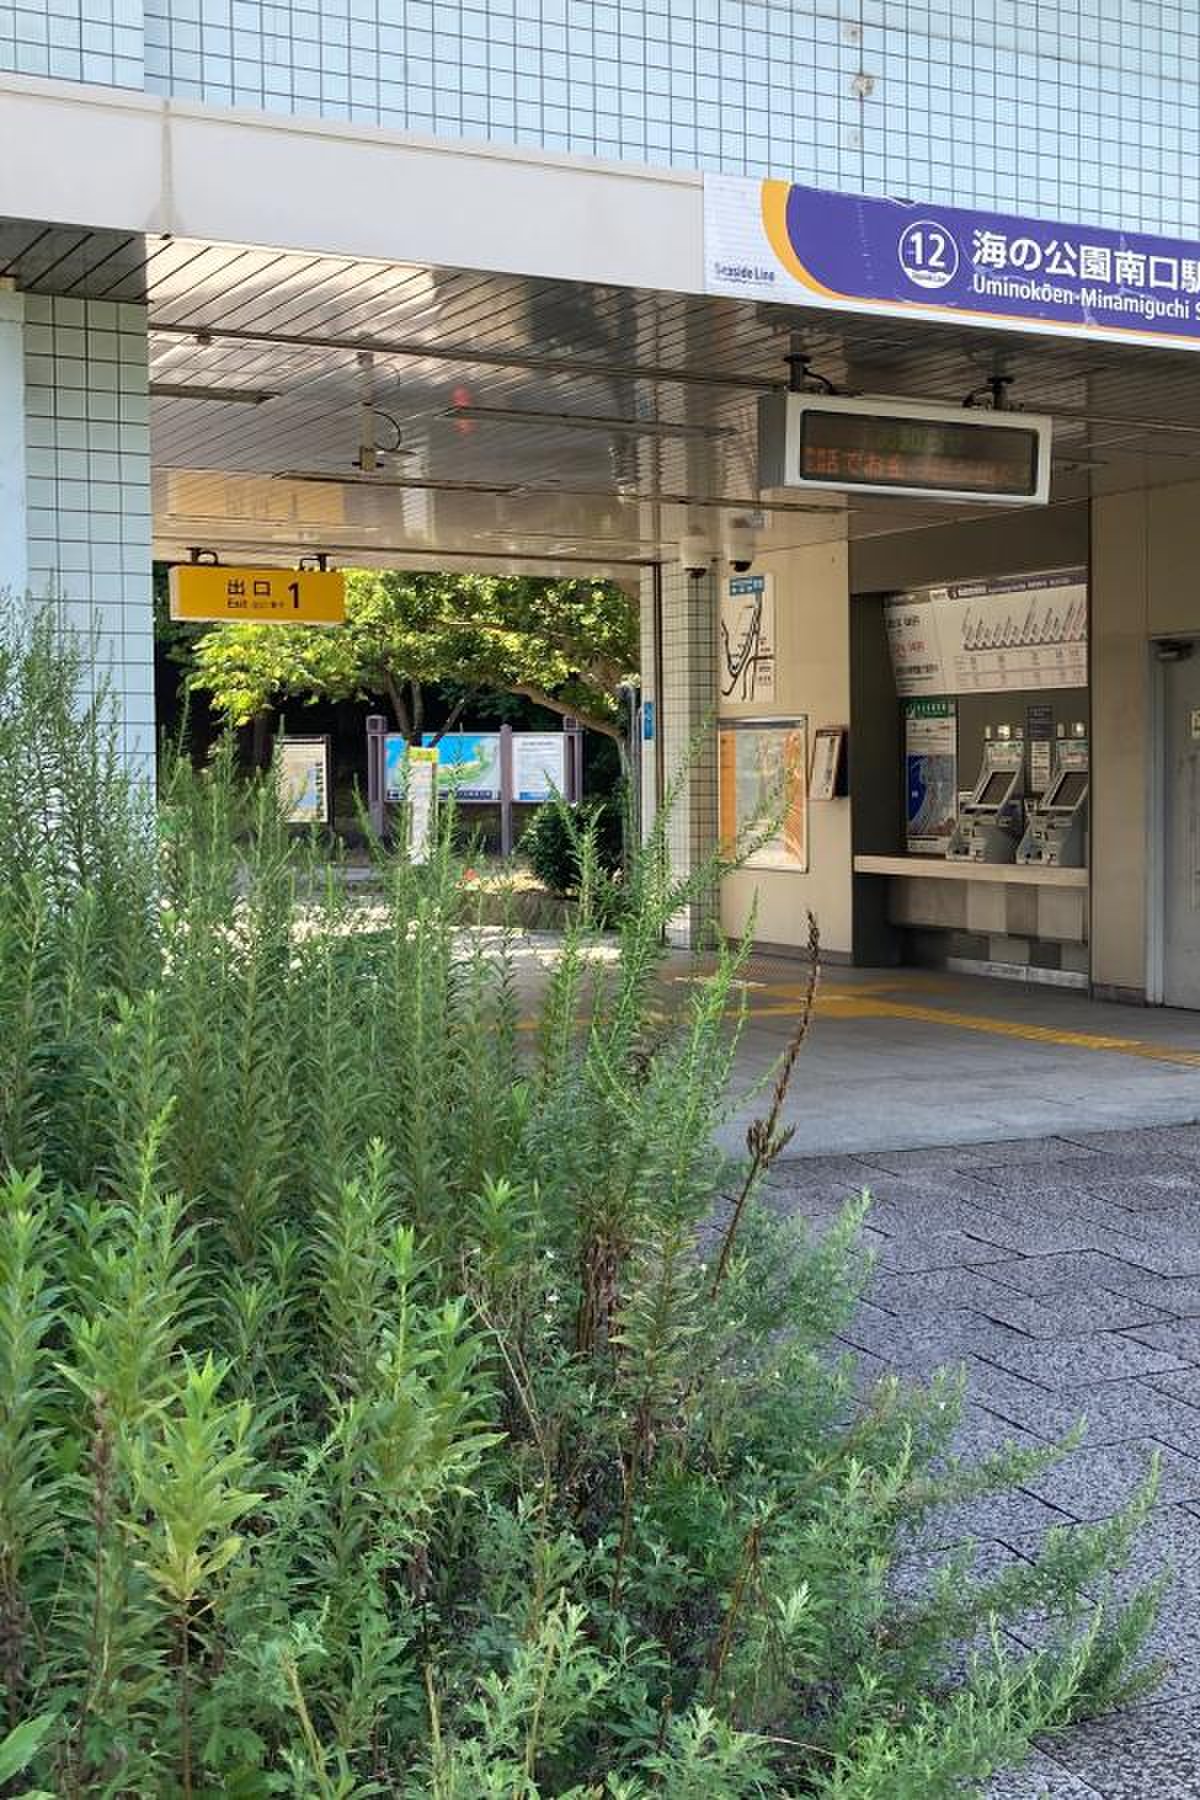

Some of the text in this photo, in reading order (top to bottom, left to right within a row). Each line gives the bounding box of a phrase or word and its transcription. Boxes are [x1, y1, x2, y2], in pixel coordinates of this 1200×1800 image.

[910, 231, 945, 267] 12
[973, 273, 1190, 320] Uminokōen-Minamiguchi
[227, 579, 271, 596] 出口
[288, 582, 299, 609] 1
